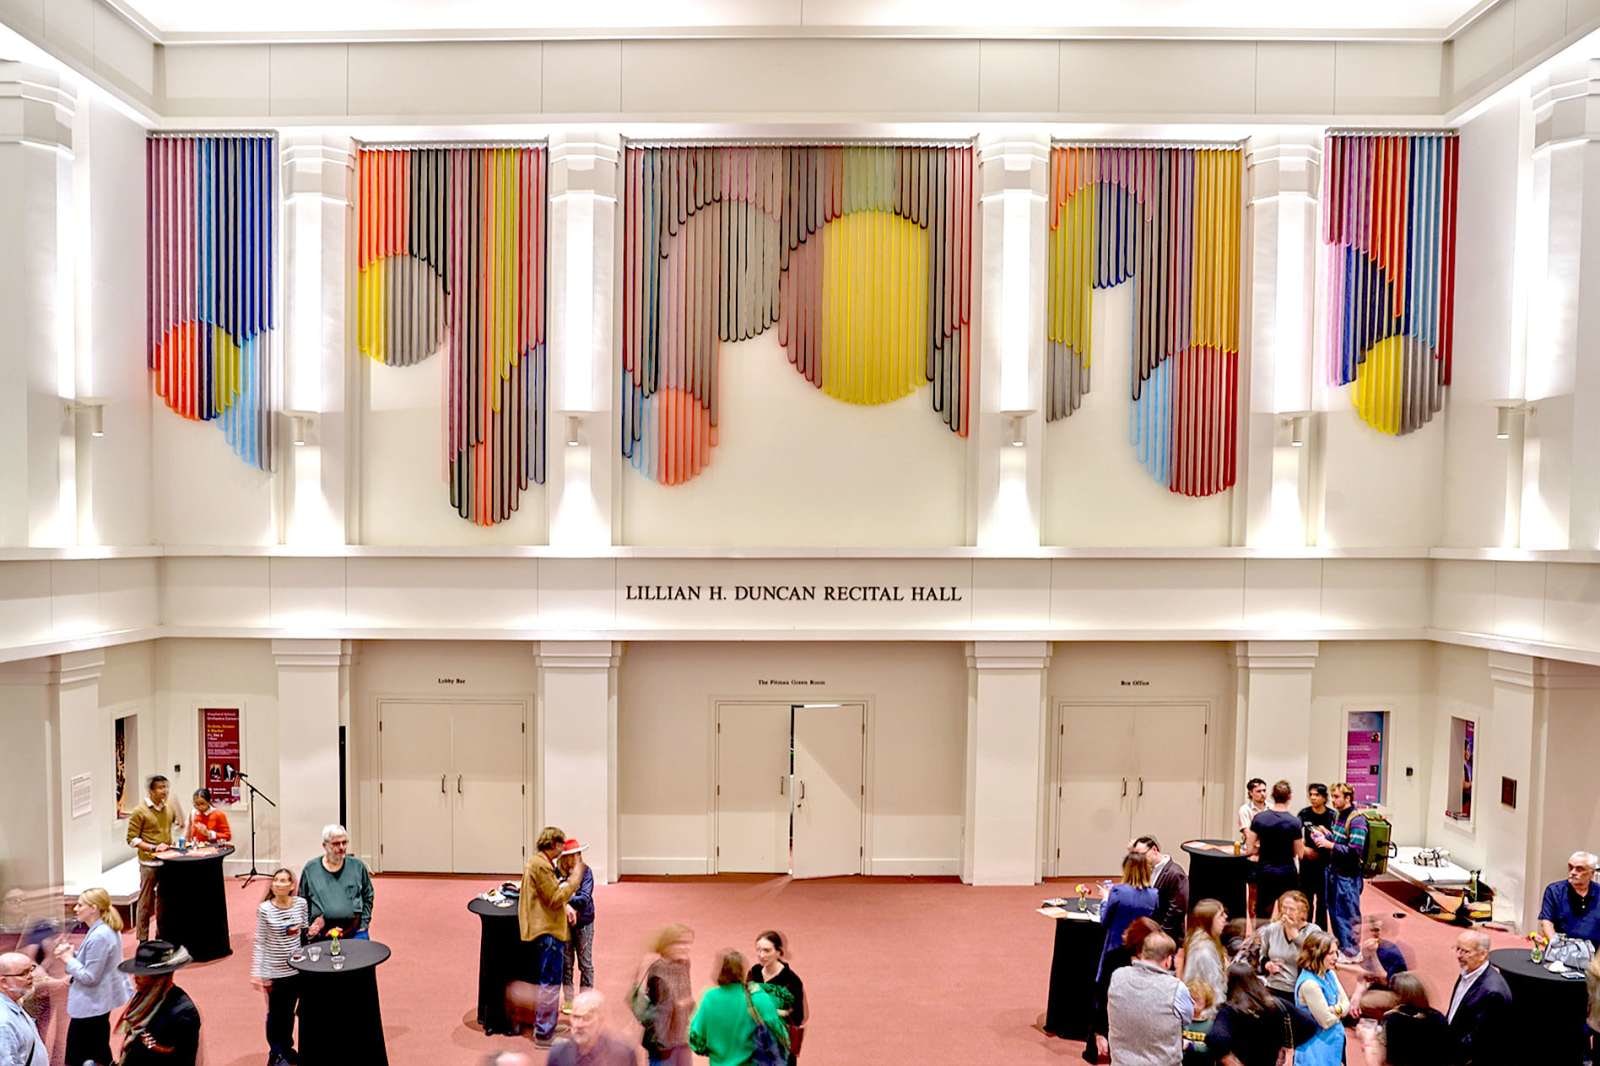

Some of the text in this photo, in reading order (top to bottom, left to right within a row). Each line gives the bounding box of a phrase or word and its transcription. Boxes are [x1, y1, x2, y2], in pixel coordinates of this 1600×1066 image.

[626, 585, 962, 601] LILLIAN H. DUNCAN RECITAL HALL
